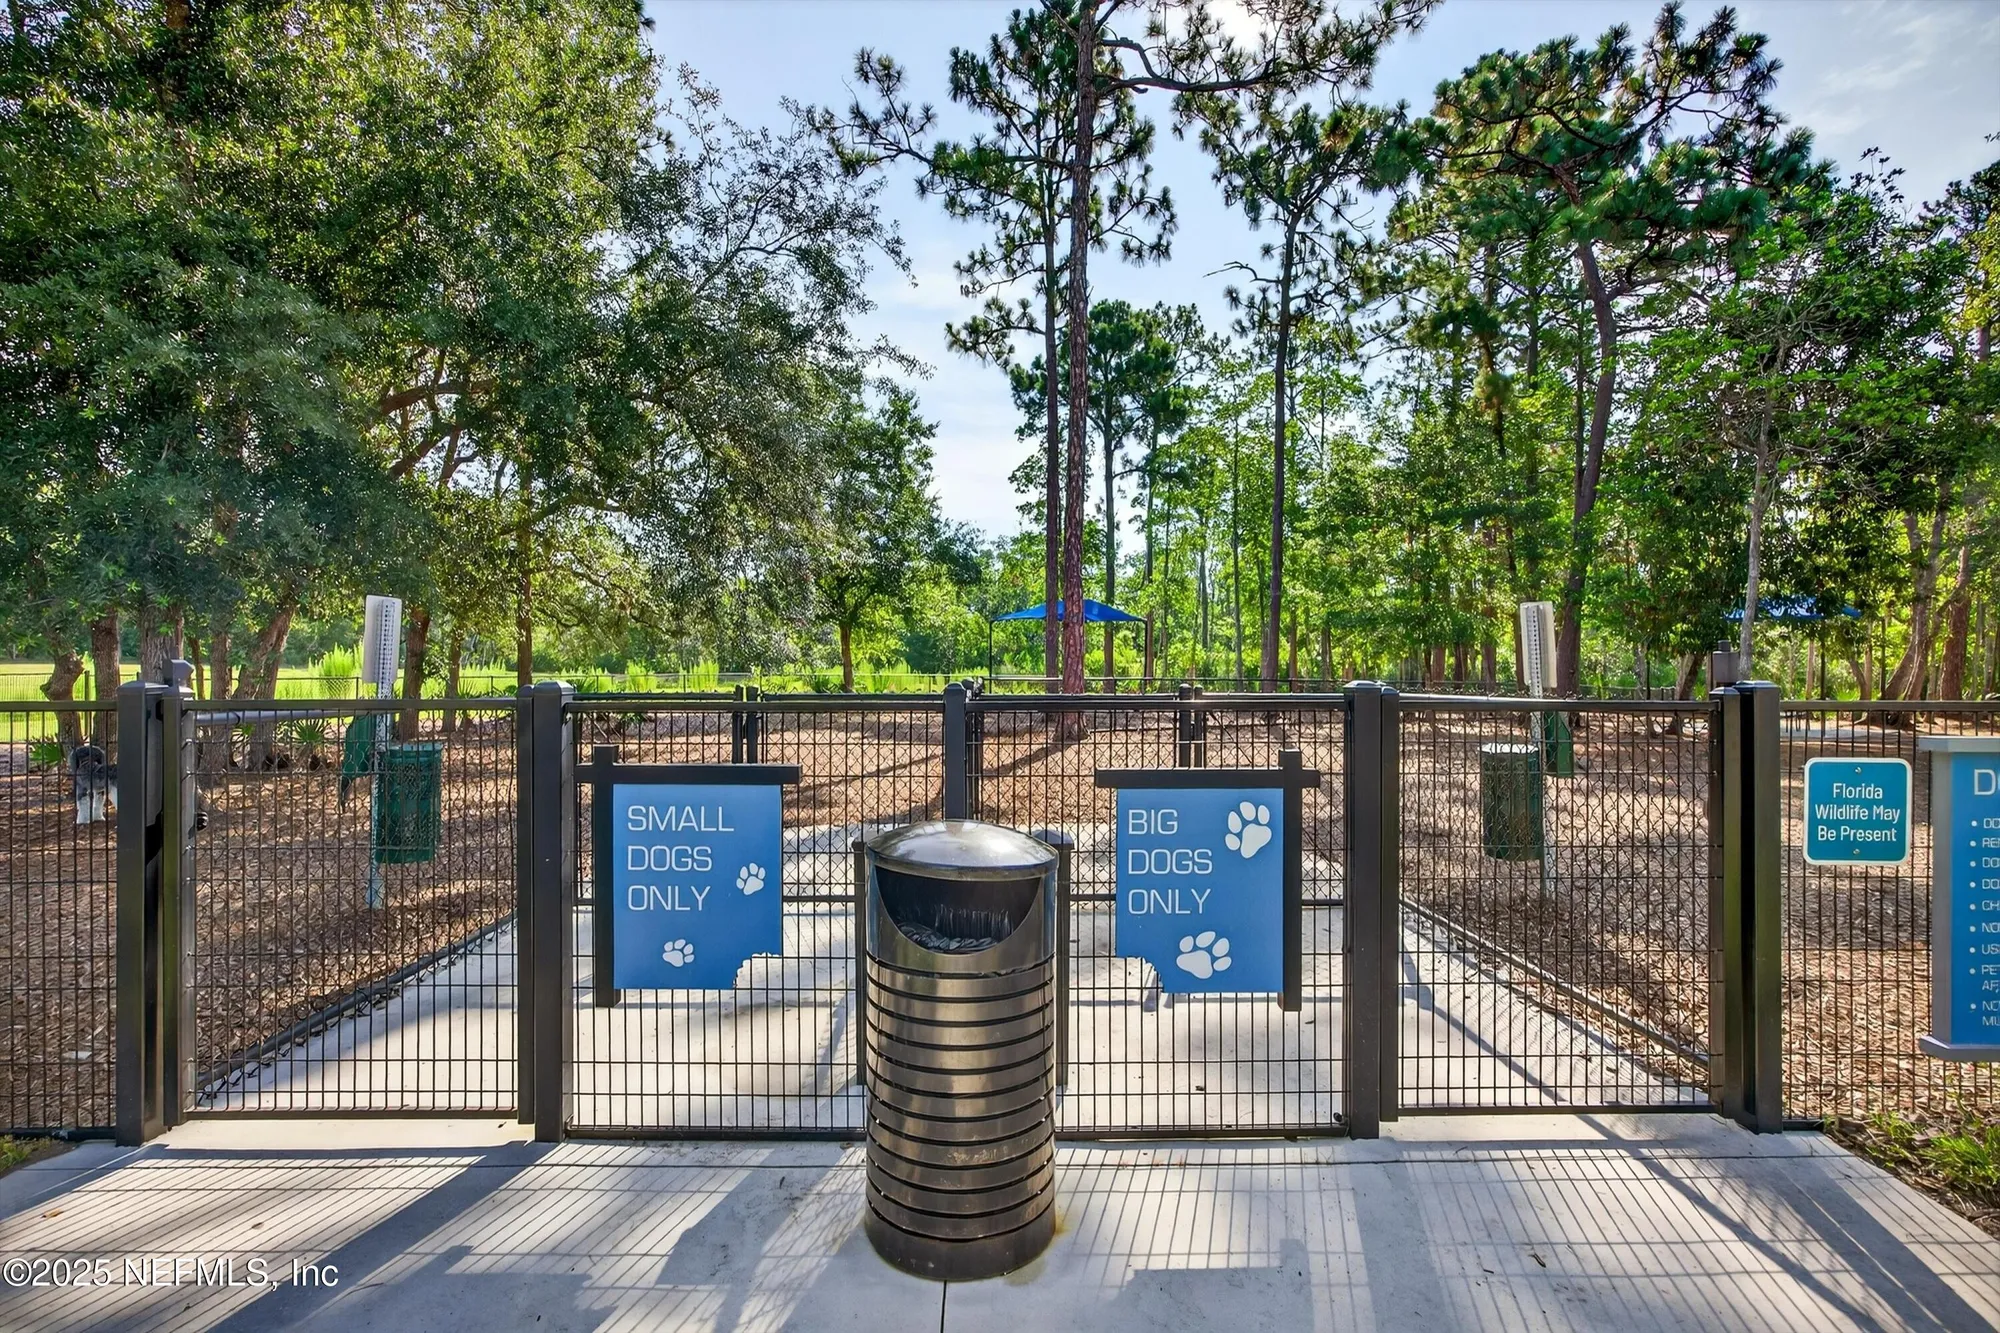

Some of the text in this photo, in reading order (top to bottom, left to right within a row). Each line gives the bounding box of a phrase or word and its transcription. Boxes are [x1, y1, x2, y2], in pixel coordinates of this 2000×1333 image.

[1833, 782, 1883, 799] Florida
[627, 805, 734, 832] SMALL
[1128, 809, 1178, 835] BIG
[1815, 804, 1900, 824] Wildlife May
[1818, 825, 1897, 842] Be Present
[627, 845, 713, 871] DOGS
[1128, 849, 1213, 875] DOGS
[627, 885, 711, 911] ONLY
[1128, 888, 1211, 914] ONLY
